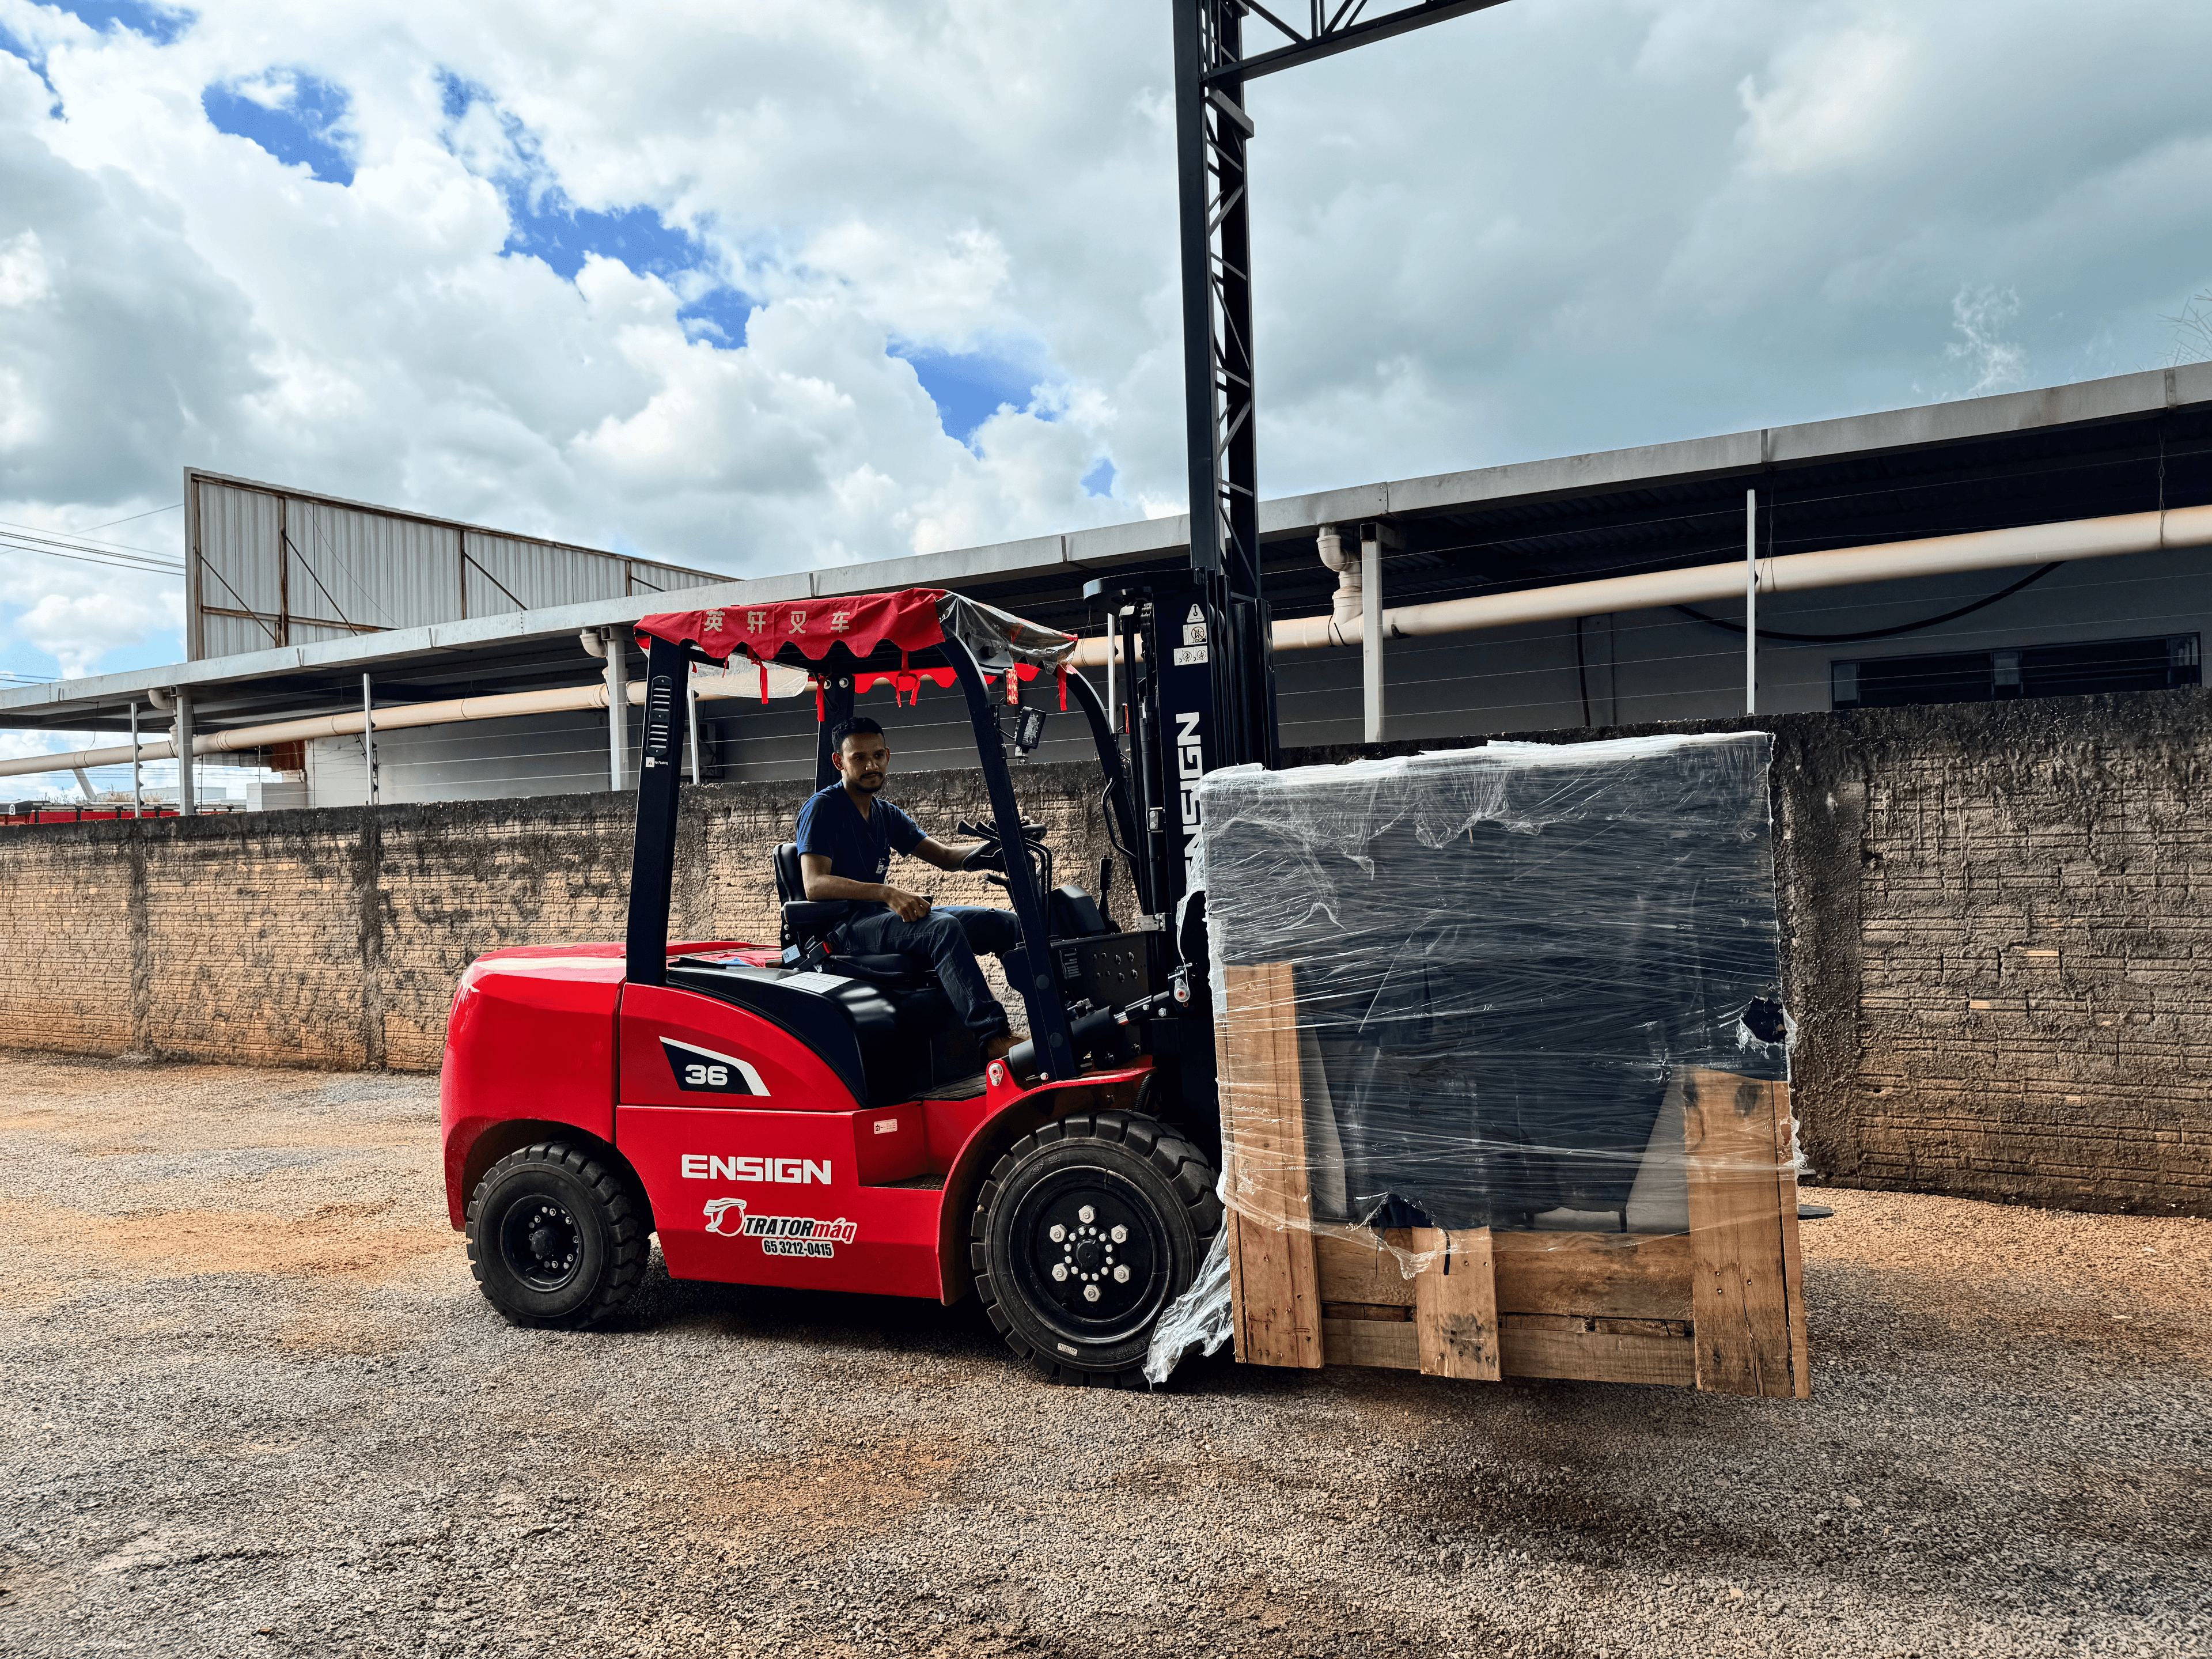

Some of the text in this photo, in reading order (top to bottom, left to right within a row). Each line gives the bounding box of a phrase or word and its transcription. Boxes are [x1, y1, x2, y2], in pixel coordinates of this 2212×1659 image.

[703, 611, 851, 634] 英轩叉车
[685, 1065, 728, 1086] 36
[681, 1154, 831, 1185] ENSIGN
[745, 1217, 855, 1241] TRATORmáq
[763, 1240, 832, 1256] 65 3212-0415
